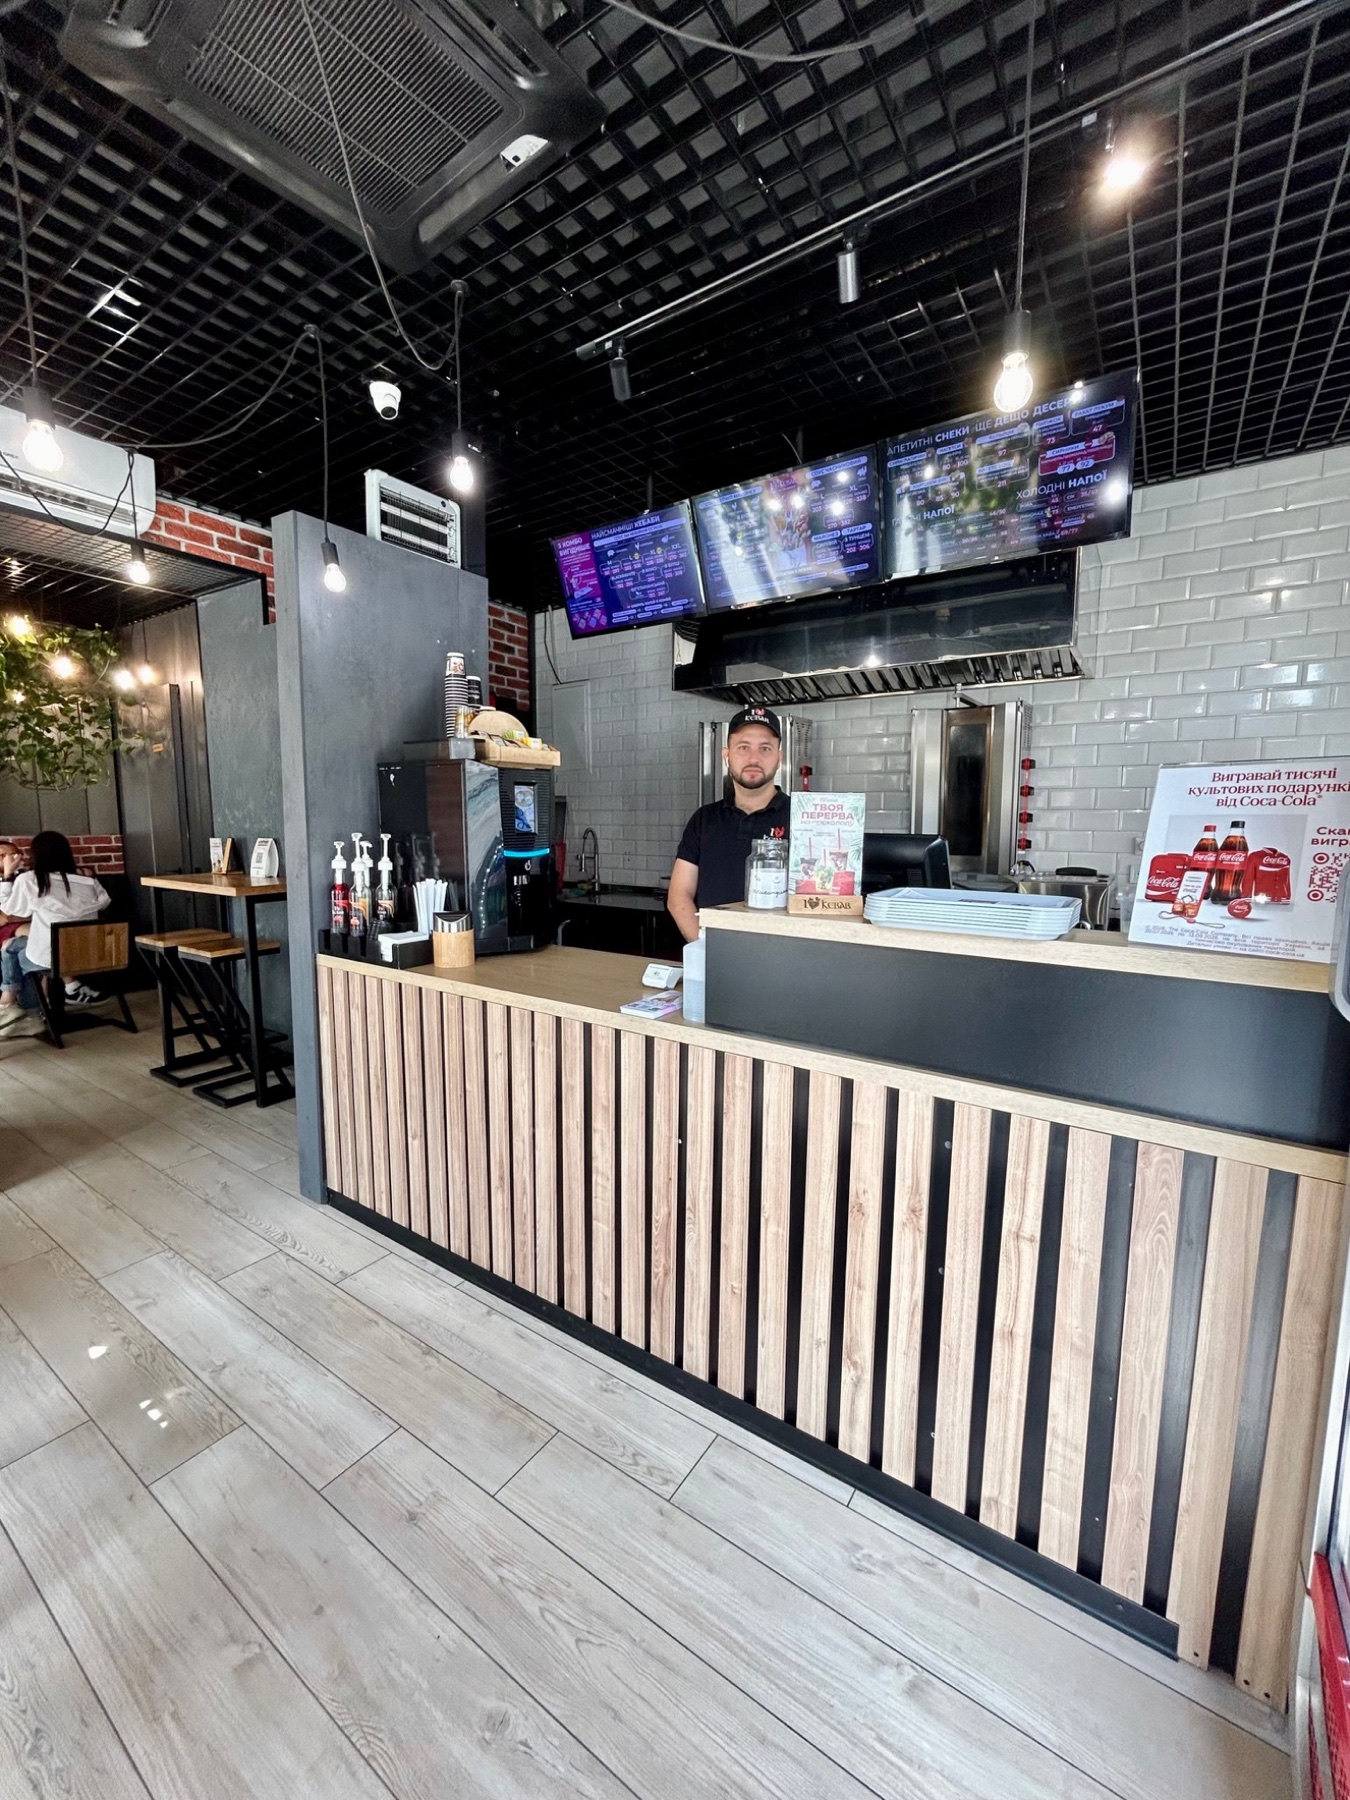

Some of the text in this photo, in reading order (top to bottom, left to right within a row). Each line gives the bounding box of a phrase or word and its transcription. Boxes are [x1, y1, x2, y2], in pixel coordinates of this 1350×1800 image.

[975, 393, 1086, 432] ЩЕ ДЕЩО ДЕСЕР
[886, 436, 933, 456] АПЕТИТНІ
[934, 426, 970, 442] СНЕКИ
[997, 449, 1006, 457] 97
[1052, 444, 1079, 456] СИРНИКИ
[957, 459, 968, 467] 100
[849, 484, 858, 492] XL
[1015, 469, 1108, 500] ХОЛОДНІ НАПОЇ
[923, 503, 956, 519] НАПОЇ
[591, 515, 660, 540] НАЙСМАЧНІШІ КЕБАБИ
[846, 525, 867, 533] ТАРТАР
[562, 537, 583, 548] КОМБО
[1211, 767, 1338, 783] Вигравай тисячі
[1188, 783, 1264, 797] культових
[812, 803, 844, 812] ТВОЯ
[1216, 796, 1237, 808] від
[801, 811, 854, 820] ПЕРЕРВА
[1310, 838, 1350, 847] вигр
